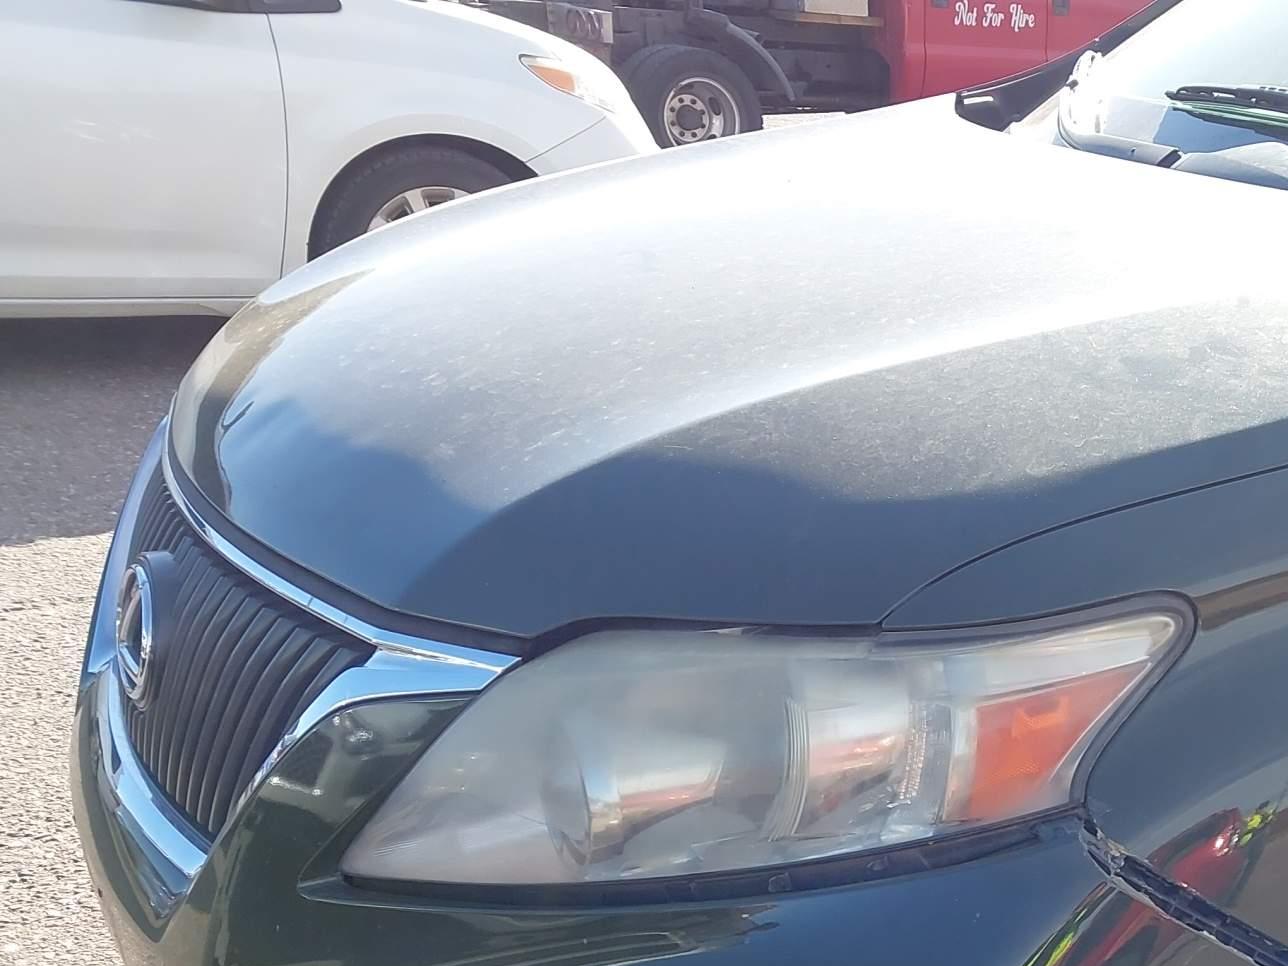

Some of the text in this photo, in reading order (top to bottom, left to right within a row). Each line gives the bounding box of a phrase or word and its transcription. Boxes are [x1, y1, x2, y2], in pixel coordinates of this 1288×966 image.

[954, 0, 1036, 32] Not For Hire
